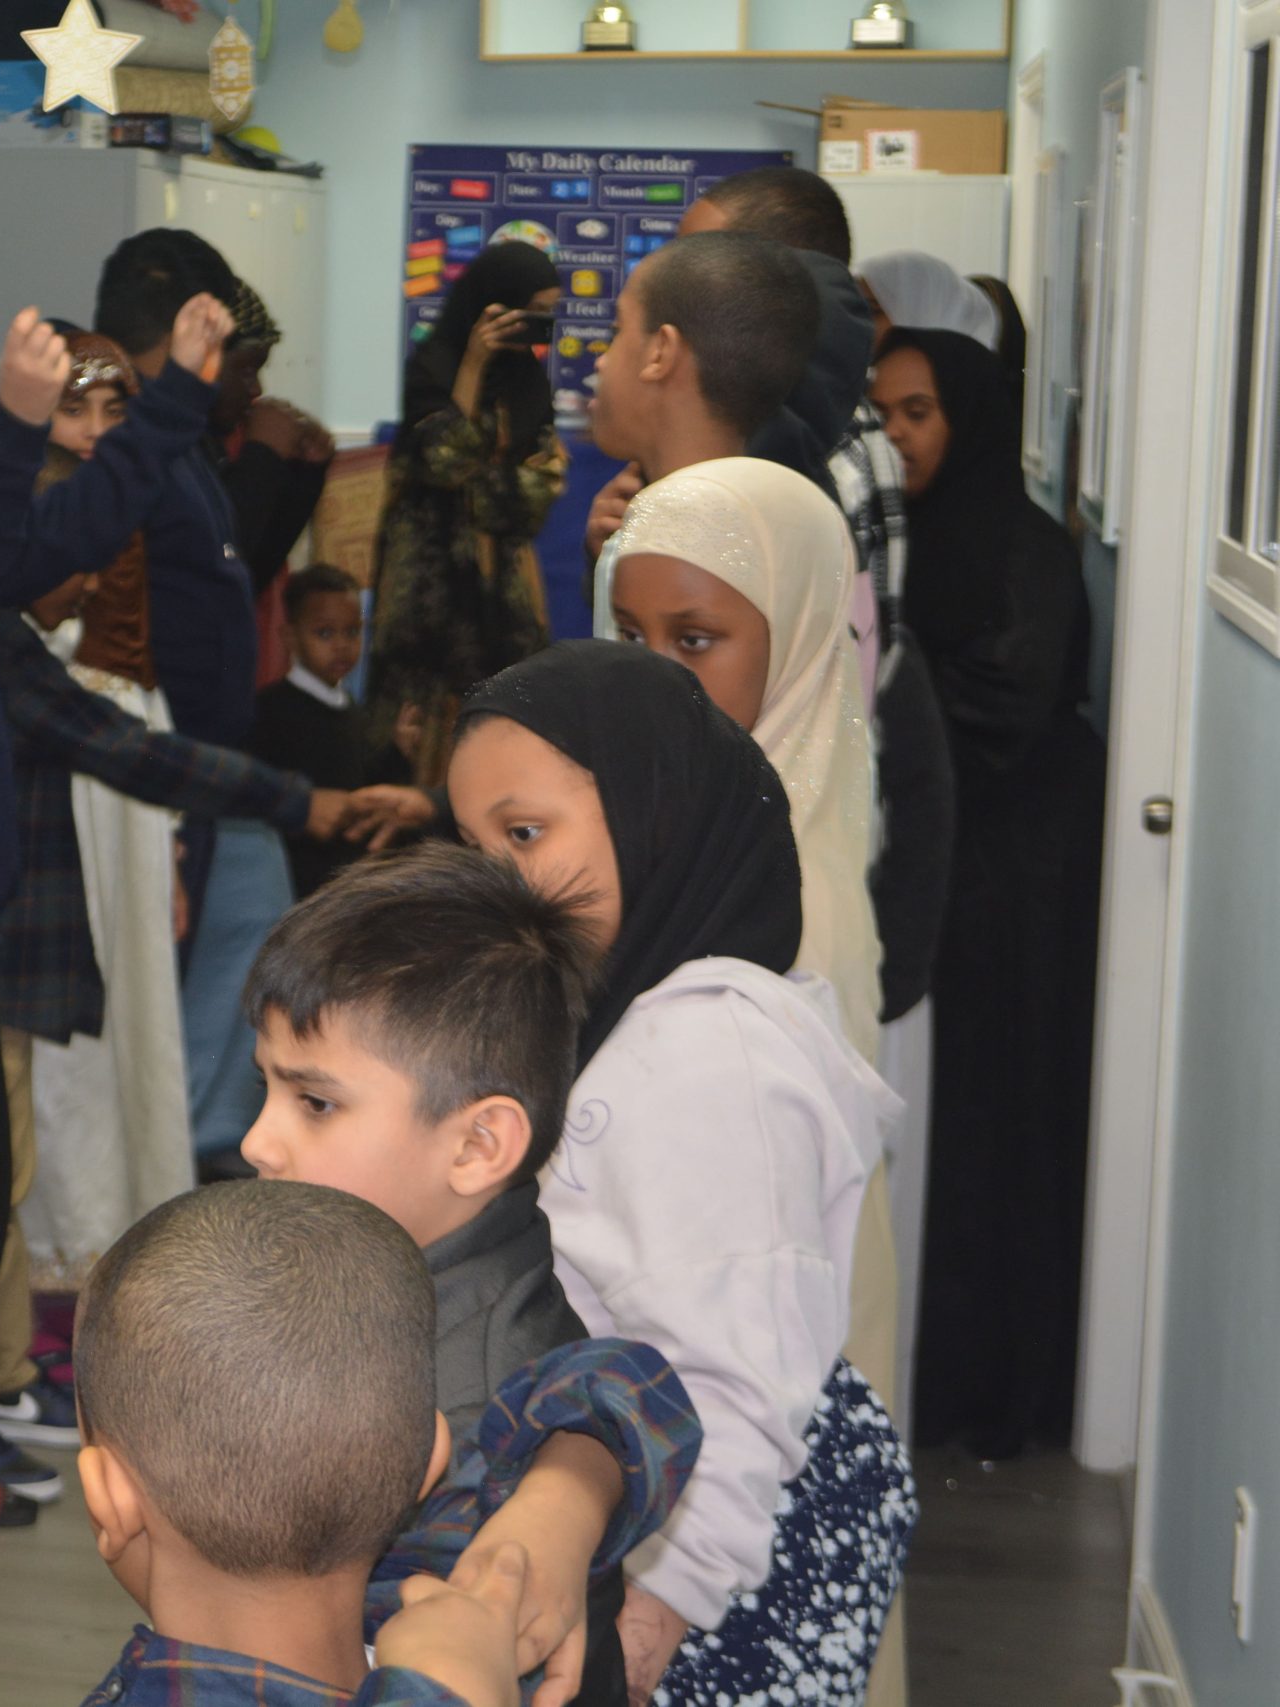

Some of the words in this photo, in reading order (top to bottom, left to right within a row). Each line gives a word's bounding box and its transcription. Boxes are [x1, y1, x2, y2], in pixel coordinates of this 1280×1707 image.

[506, 152, 536, 172] My
[541, 152, 593, 174] Daily
[598, 153, 694, 173] Calendar
[558, 250, 616, 263] Weather
